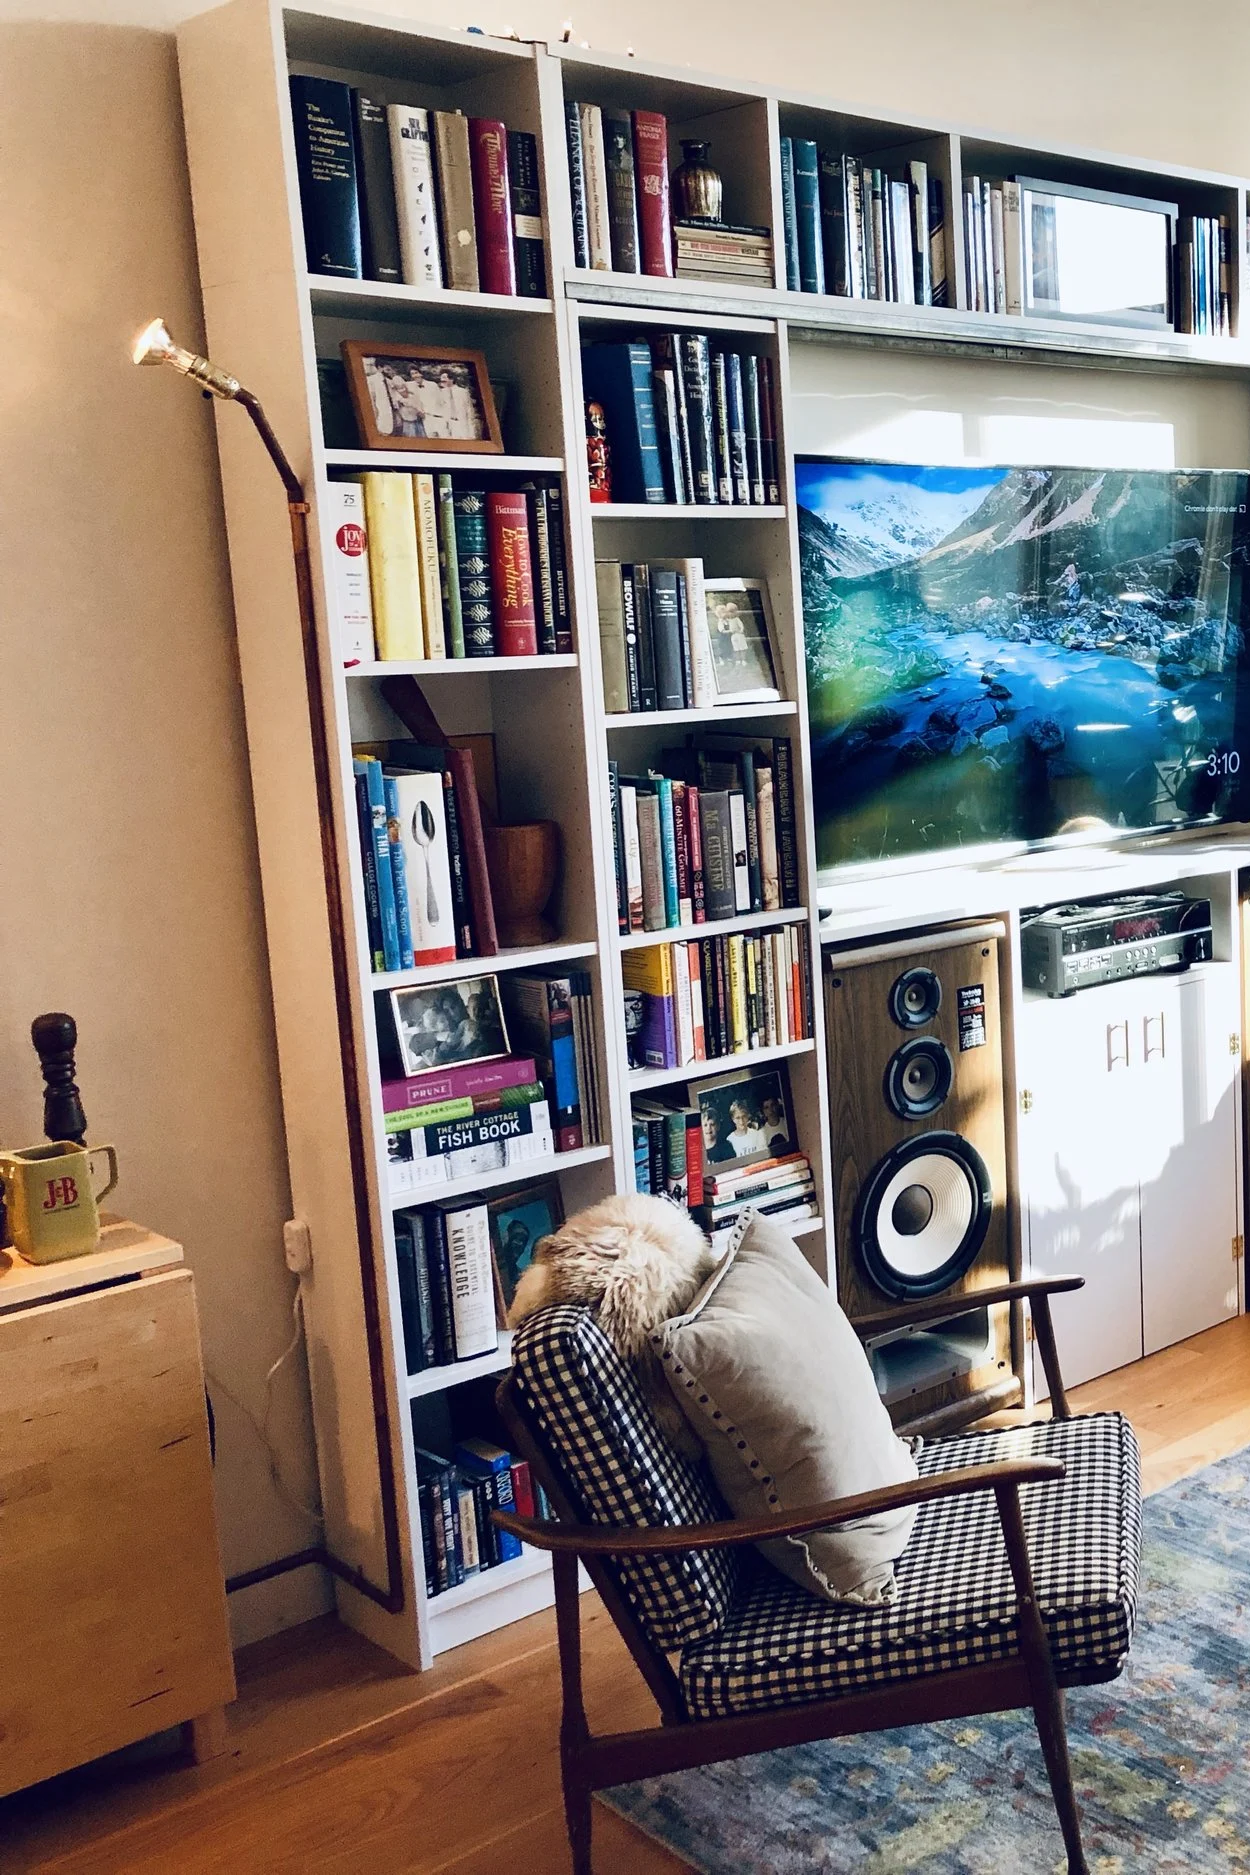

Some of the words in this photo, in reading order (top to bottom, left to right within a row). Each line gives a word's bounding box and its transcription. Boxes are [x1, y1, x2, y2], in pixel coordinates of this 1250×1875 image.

[306, 103, 320, 112] The
[307, 114, 334, 124] Reader's
[310, 144, 335, 155] History
[344, 494, 355, 504] 75
[495, 505, 526, 515] Bittman
[423, 499, 437, 573] MOMOFUKU
[517, 525, 529, 558] How
[499, 526, 521, 609] Everything
[519, 559, 528, 571] to
[520, 571, 533, 607] Cook
[557, 570, 566, 617] BUTCHERY
[623, 580, 636, 631] BEOWULF
[1206, 751, 1240, 776] 3:10
[675, 805, 685, 852] 60-MINUTE
[705, 809, 719, 830] Ma
[377, 833, 390, 858] THAI
[366, 851, 376, 884] COLLEGE
[453, 854, 462, 876] Indian
[678, 854, 686, 894] GOURMET
[707, 835, 724, 891] CUISINE
[369, 885, 379, 918] COOKING
[455, 876, 465, 903] Cooking
[397, 907, 409, 936] Scoop
[411, 1084, 447, 1099] PRUNE
[437, 1125, 454, 1135] THE
[456, 1120, 480, 1131] RIVER
[483, 1111, 519, 1127] COTTAGE
[438, 1130, 473, 1150] FISH
[480, 1120, 520, 1141] BOOK
[452, 1228, 470, 1299] KNOWLEDGE
[469, 1259, 479, 1295] ESSENTIAL
[496, 1471, 513, 1505] OXFORD
